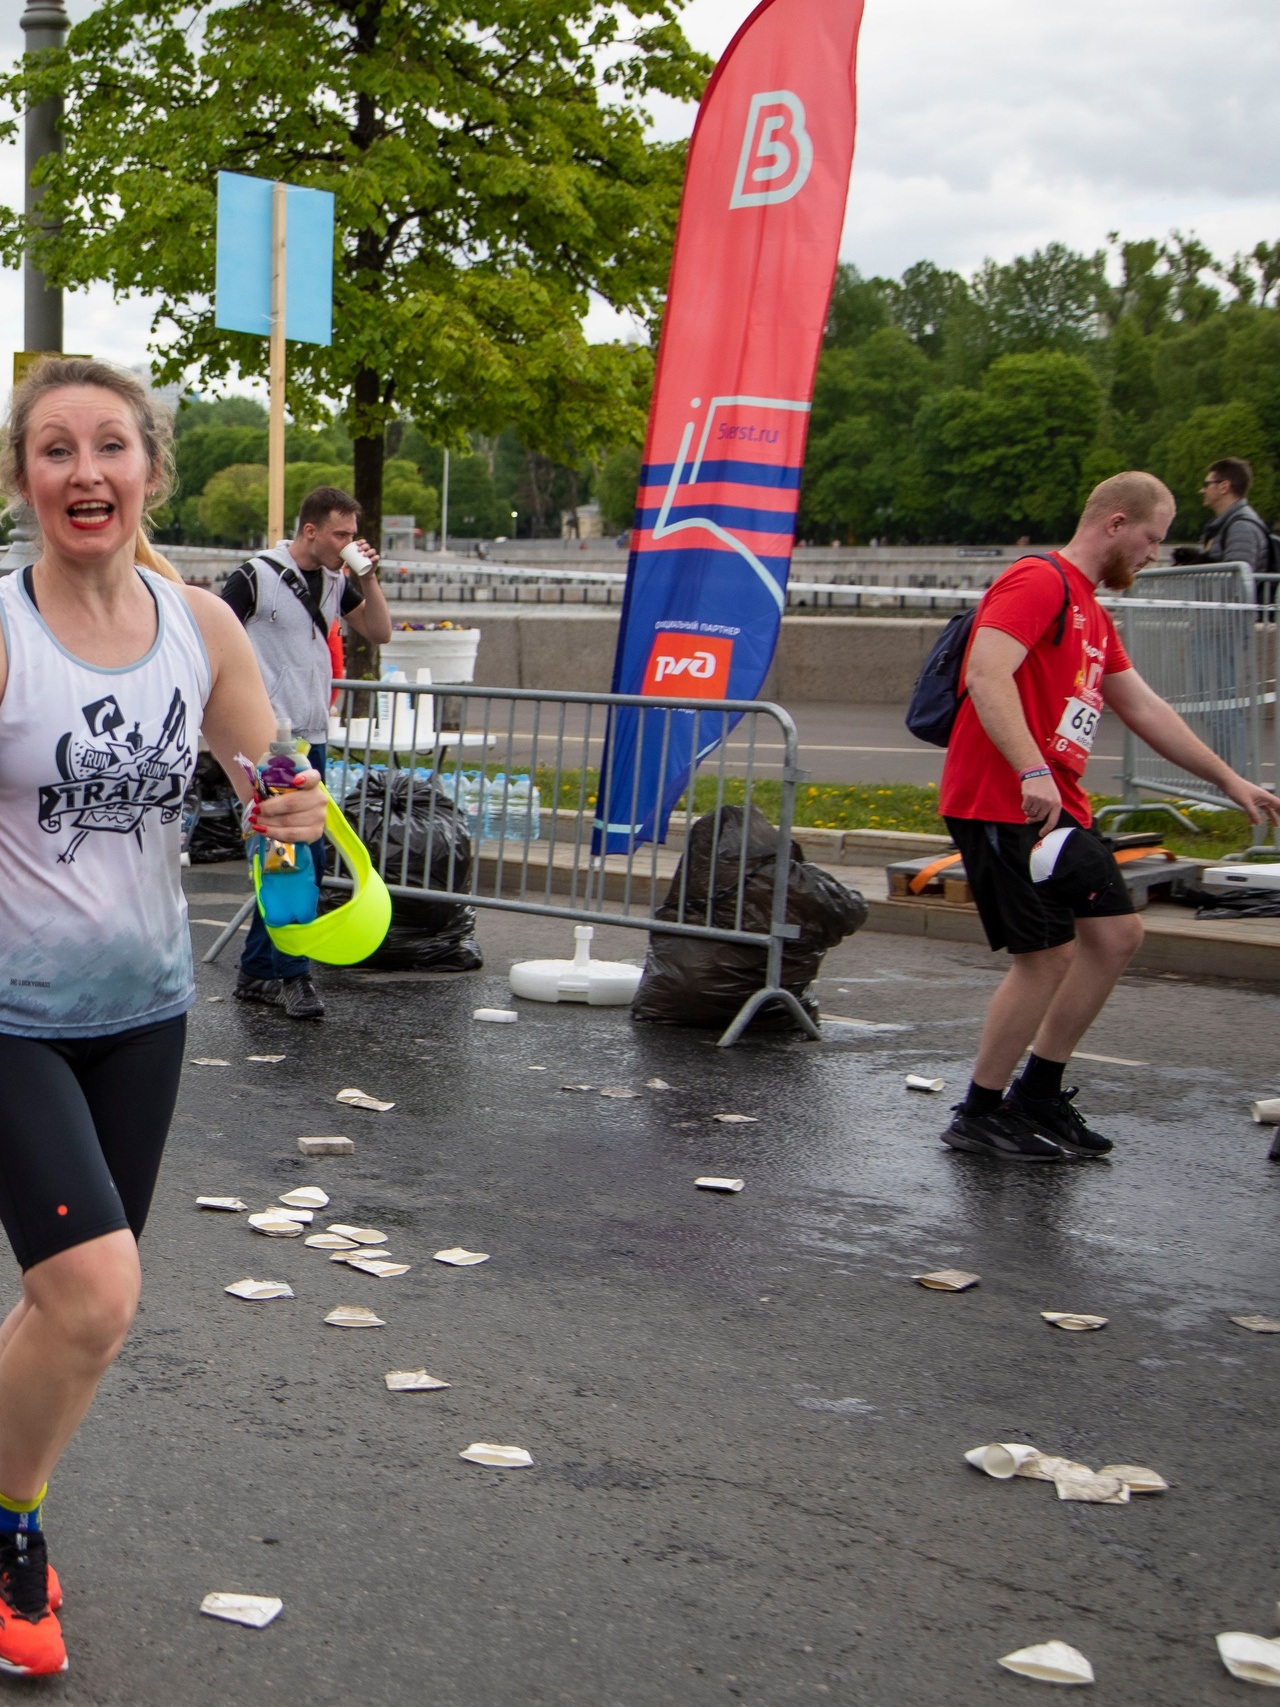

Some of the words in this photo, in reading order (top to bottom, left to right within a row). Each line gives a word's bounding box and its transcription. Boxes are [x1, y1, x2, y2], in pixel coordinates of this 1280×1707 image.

[1055, 738, 1068, 752] G
[84, 752, 111, 770] RUN
[139, 760, 169, 780] RUN!
[58, 778, 160, 809] TRAIL
